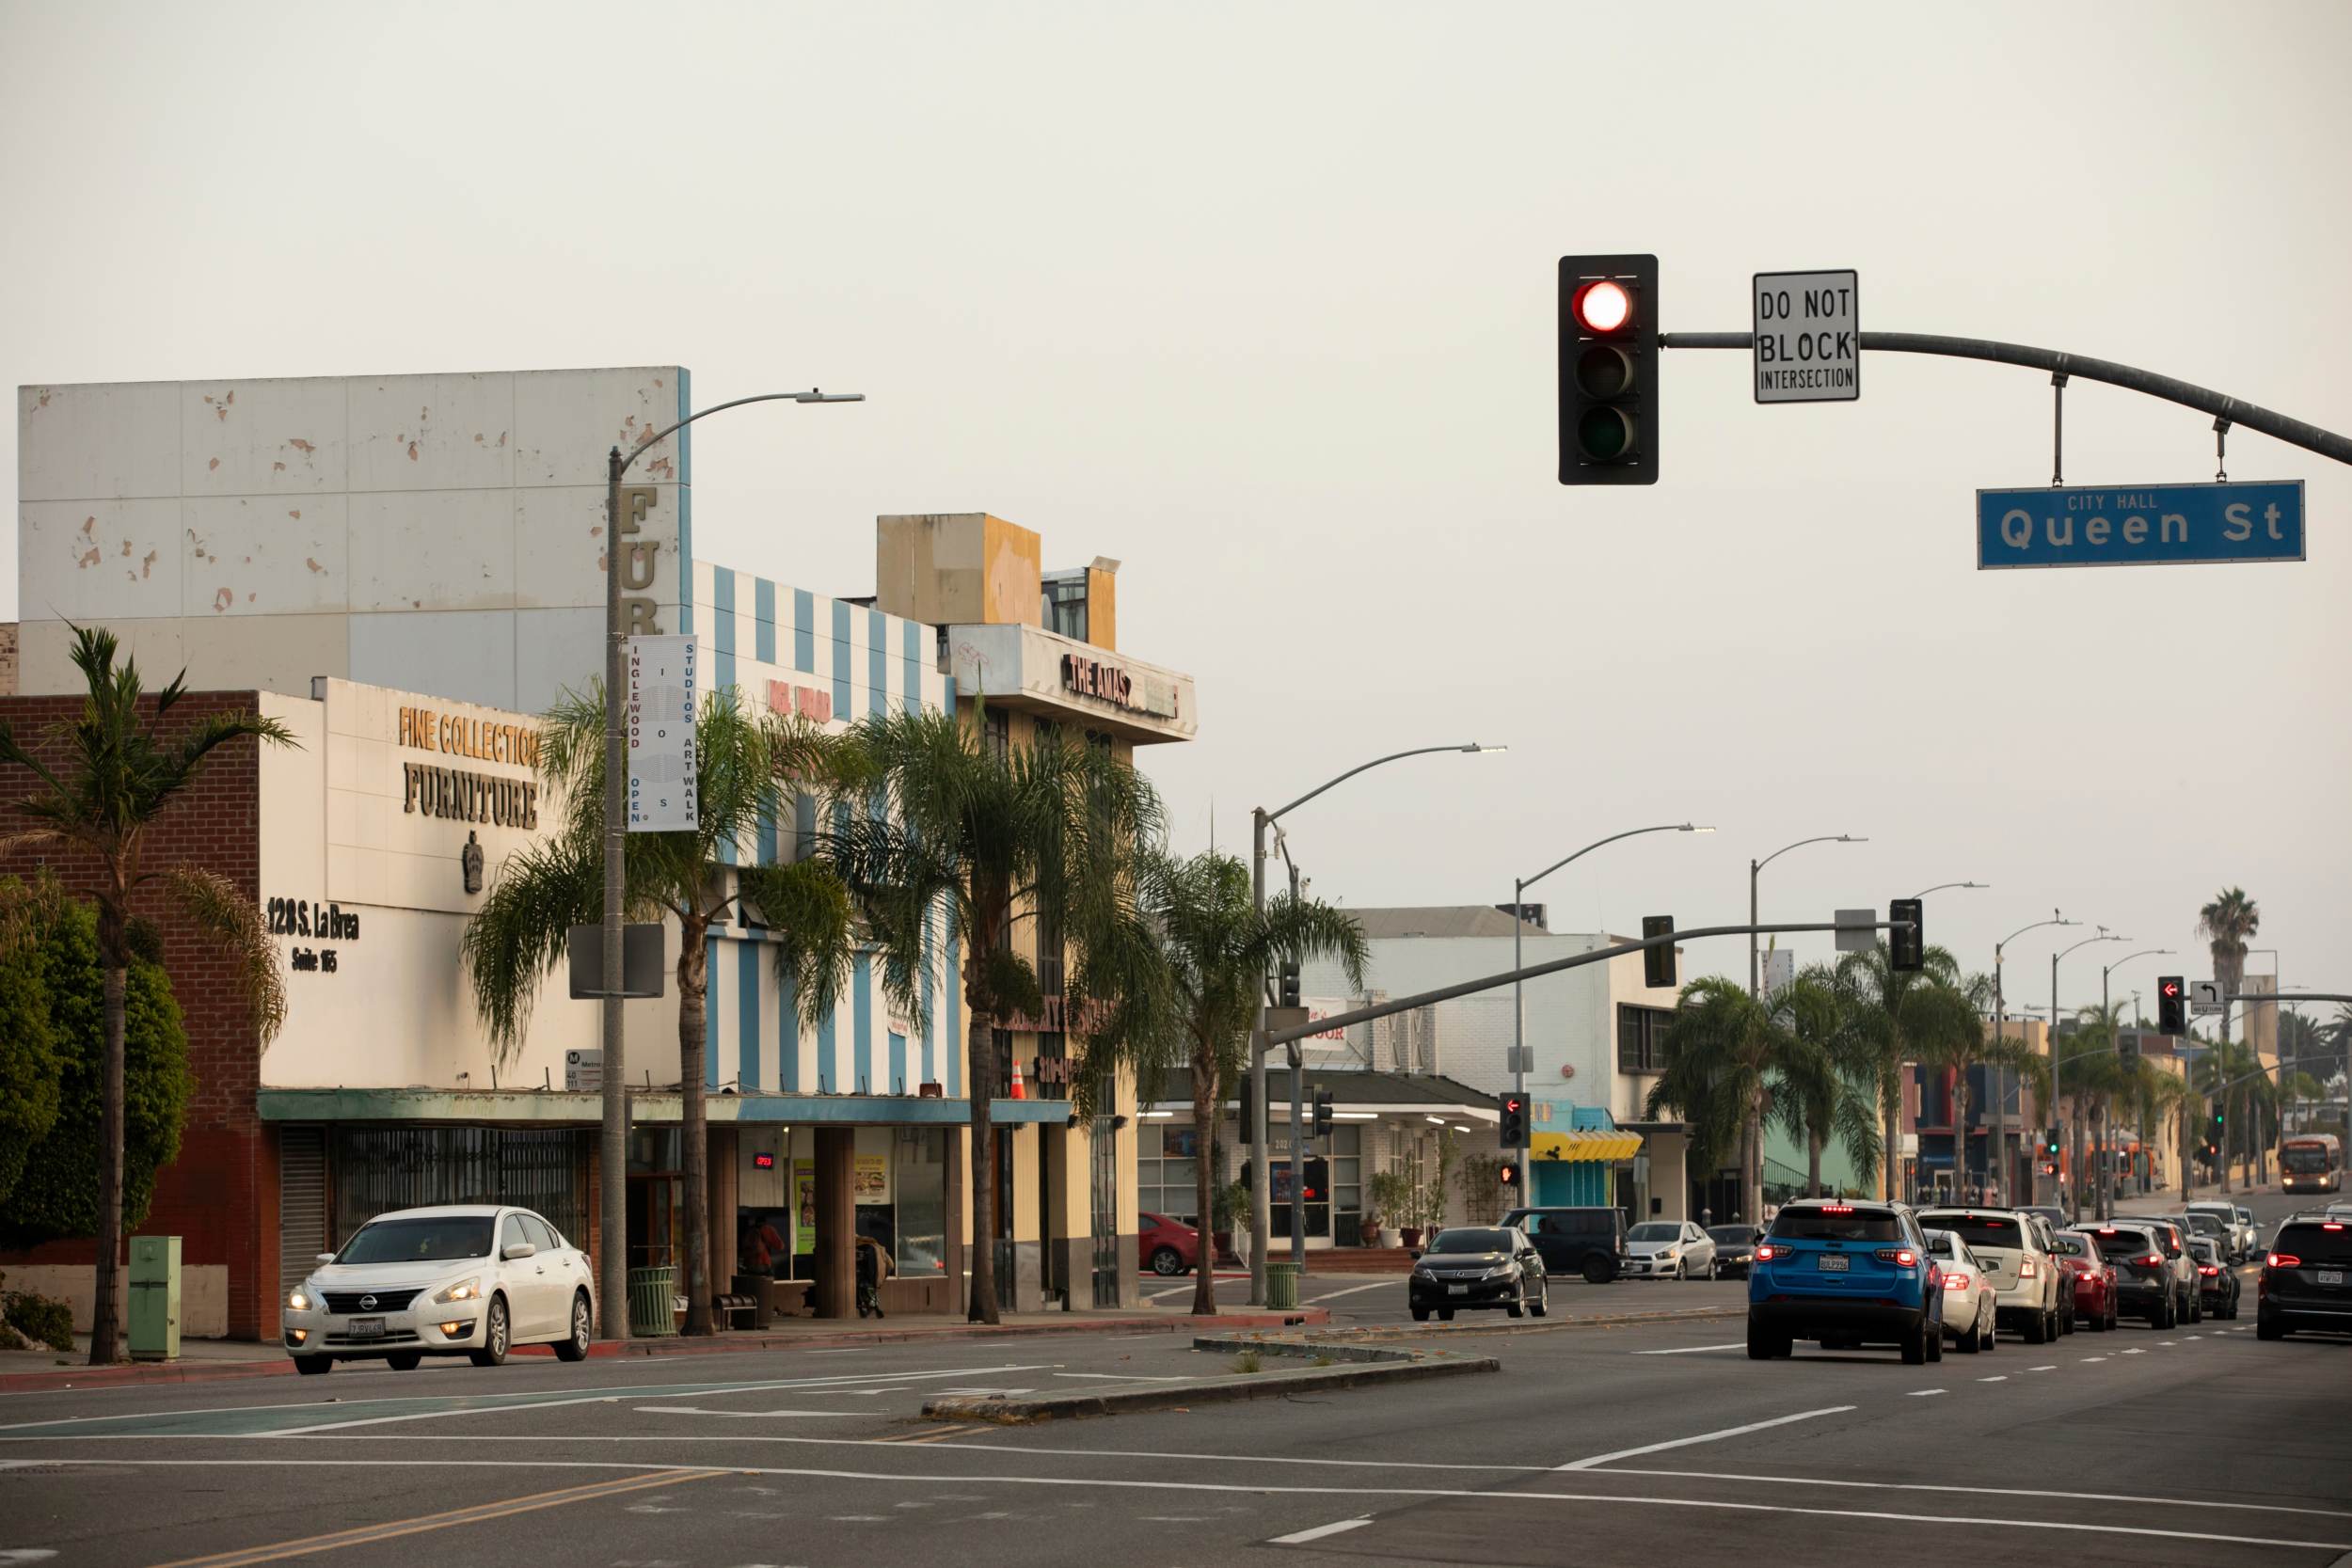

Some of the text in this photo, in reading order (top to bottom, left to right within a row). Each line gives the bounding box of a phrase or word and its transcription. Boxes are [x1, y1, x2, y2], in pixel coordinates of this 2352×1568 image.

[1761, 289, 1850, 320] DO NOT
[1760, 331, 1851, 362] BLOCK
[1760, 368, 1853, 389] INTERSECTION
[2068, 494, 2158, 511] CITY HALL
[2001, 502, 2283, 549] Queen St
[684, 643, 693, 723] STUDIOS
[1070, 654, 1094, 695] THE
[400, 706, 542, 767] FINE COLLECTION
[630, 645, 641, 822] INGLEWOOD OPEN
[404, 762, 537, 830] FURNITURE
[268, 896, 296, 936] 128
